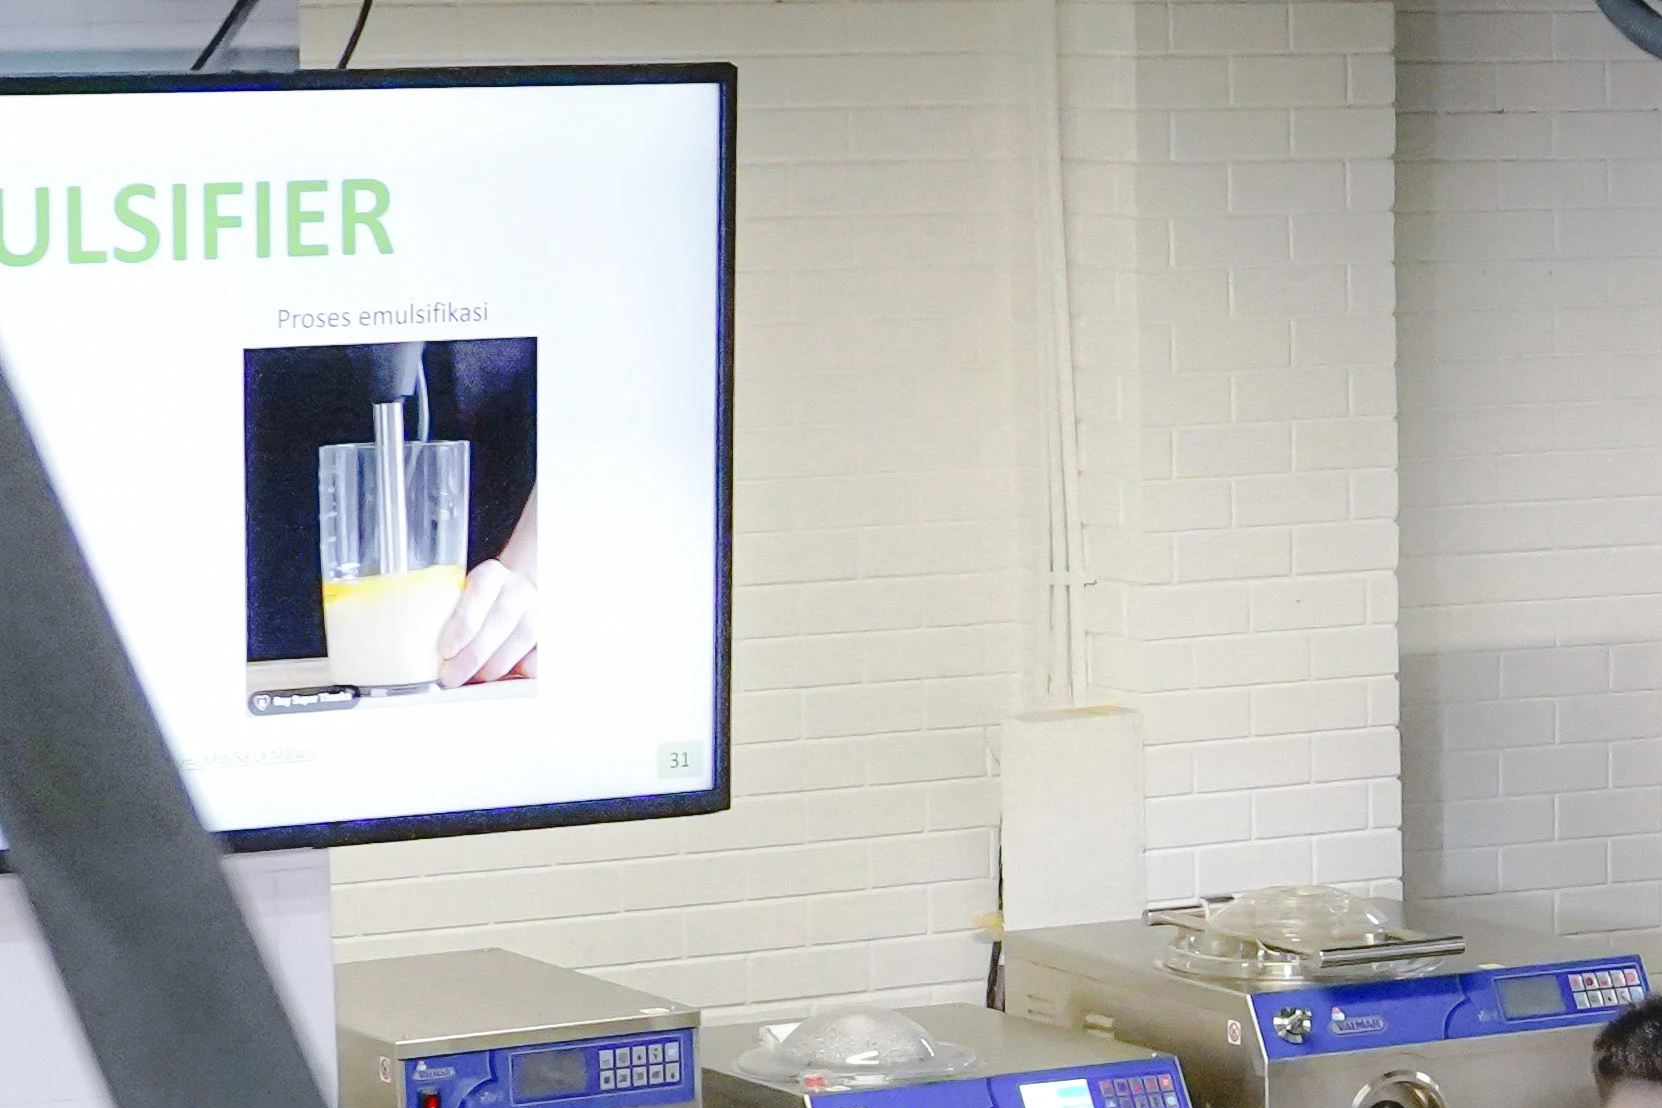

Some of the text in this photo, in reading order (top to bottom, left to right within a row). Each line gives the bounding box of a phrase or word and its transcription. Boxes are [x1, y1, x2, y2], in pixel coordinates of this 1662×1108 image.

[0, 178, 394, 267] ULSIFIER
[278, 301, 489, 329] Proses emulsifikasi
[670, 751, 689, 769] 31
